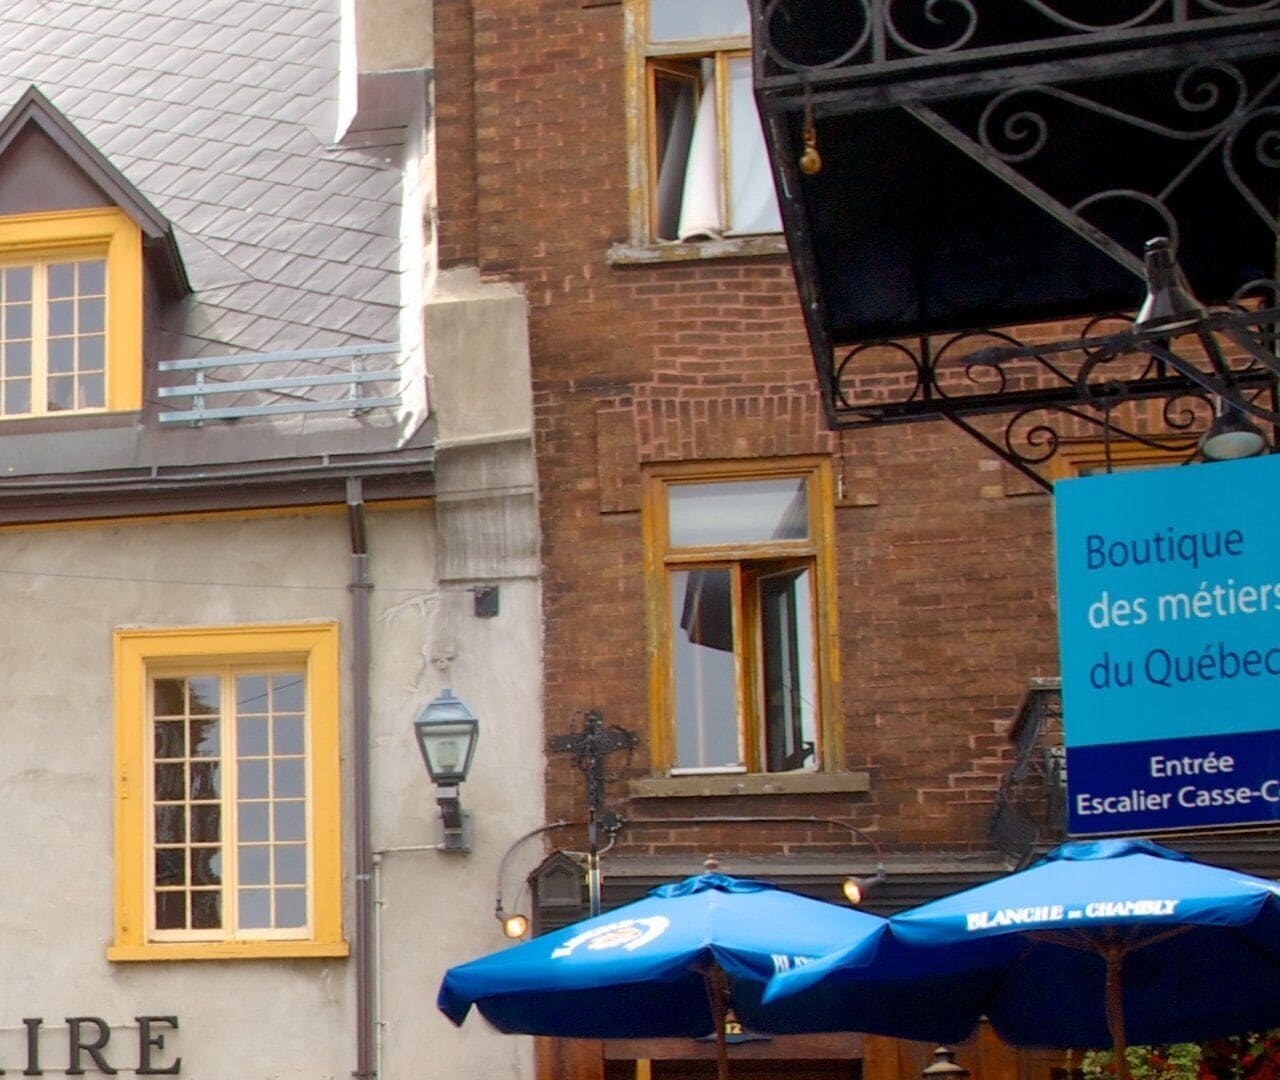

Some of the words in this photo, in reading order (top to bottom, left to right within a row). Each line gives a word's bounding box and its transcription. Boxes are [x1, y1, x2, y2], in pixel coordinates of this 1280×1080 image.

[1086, 527, 1245, 570] Boutique
[1089, 592, 1148, 629] des
[1090, 652, 1133, 690] du
[1145, 643, 1280, 688] Québec
[1150, 753, 1235, 779] Entrée
[1076, 783, 1172, 816] Escalier
[966, 905, 1064, 932] BLANCHE
[1085, 899, 1180, 919] CHAMBLY
